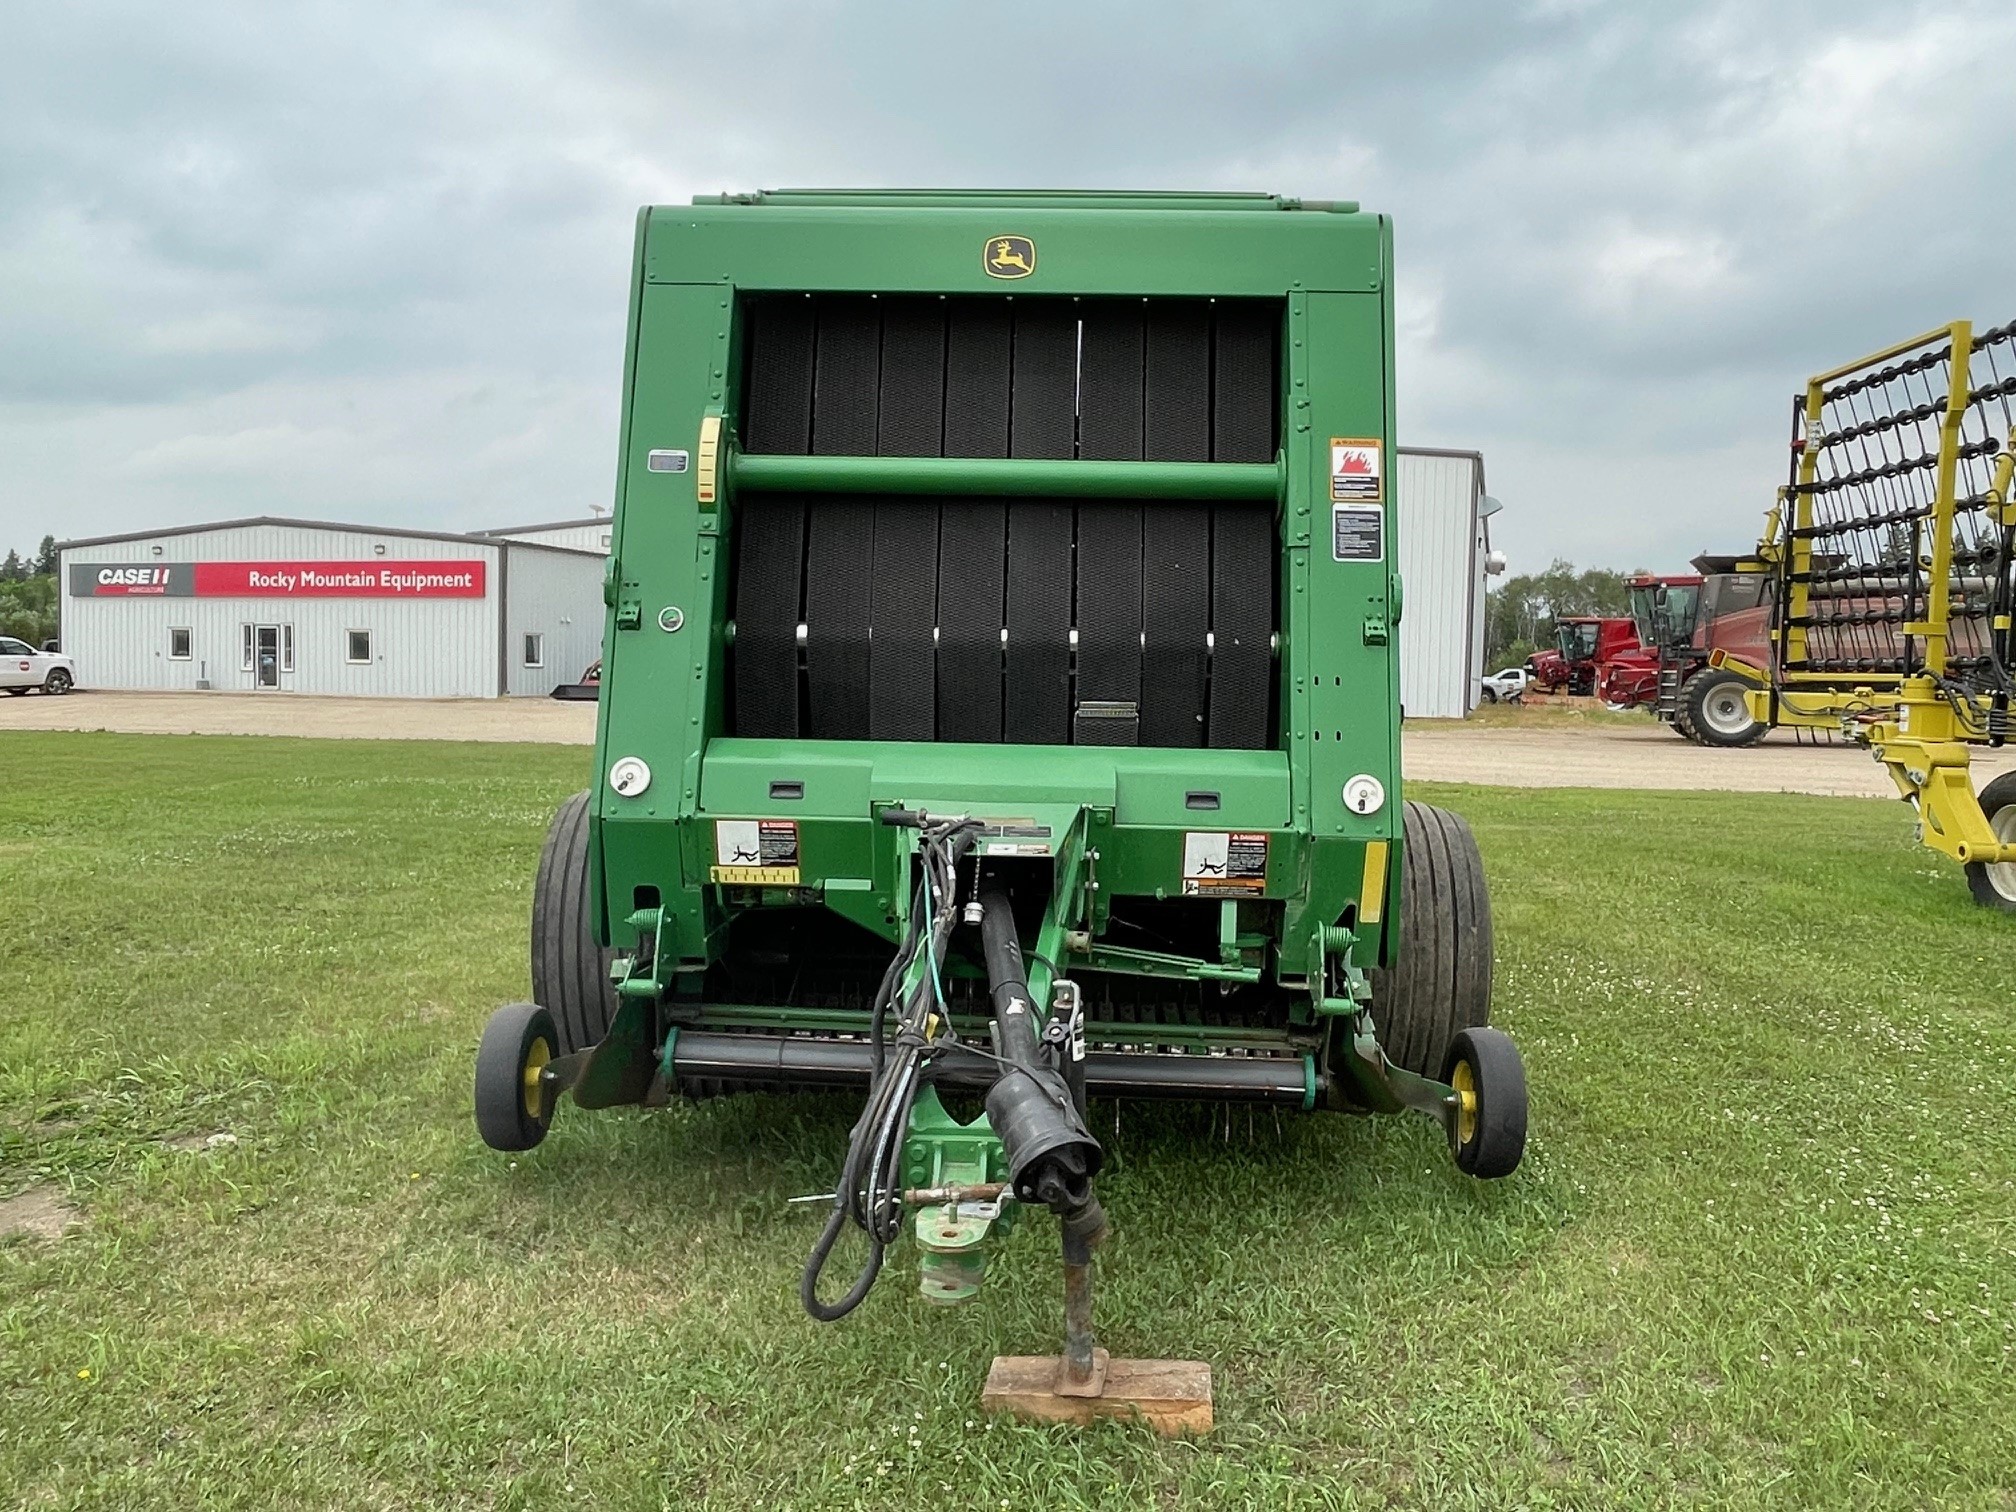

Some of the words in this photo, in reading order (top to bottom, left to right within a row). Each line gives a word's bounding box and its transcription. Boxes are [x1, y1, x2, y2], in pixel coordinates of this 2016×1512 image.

[249, 570, 296, 591] Rocky
[300, 570, 375, 587] Mountain
[380, 570, 472, 591] Equipment
